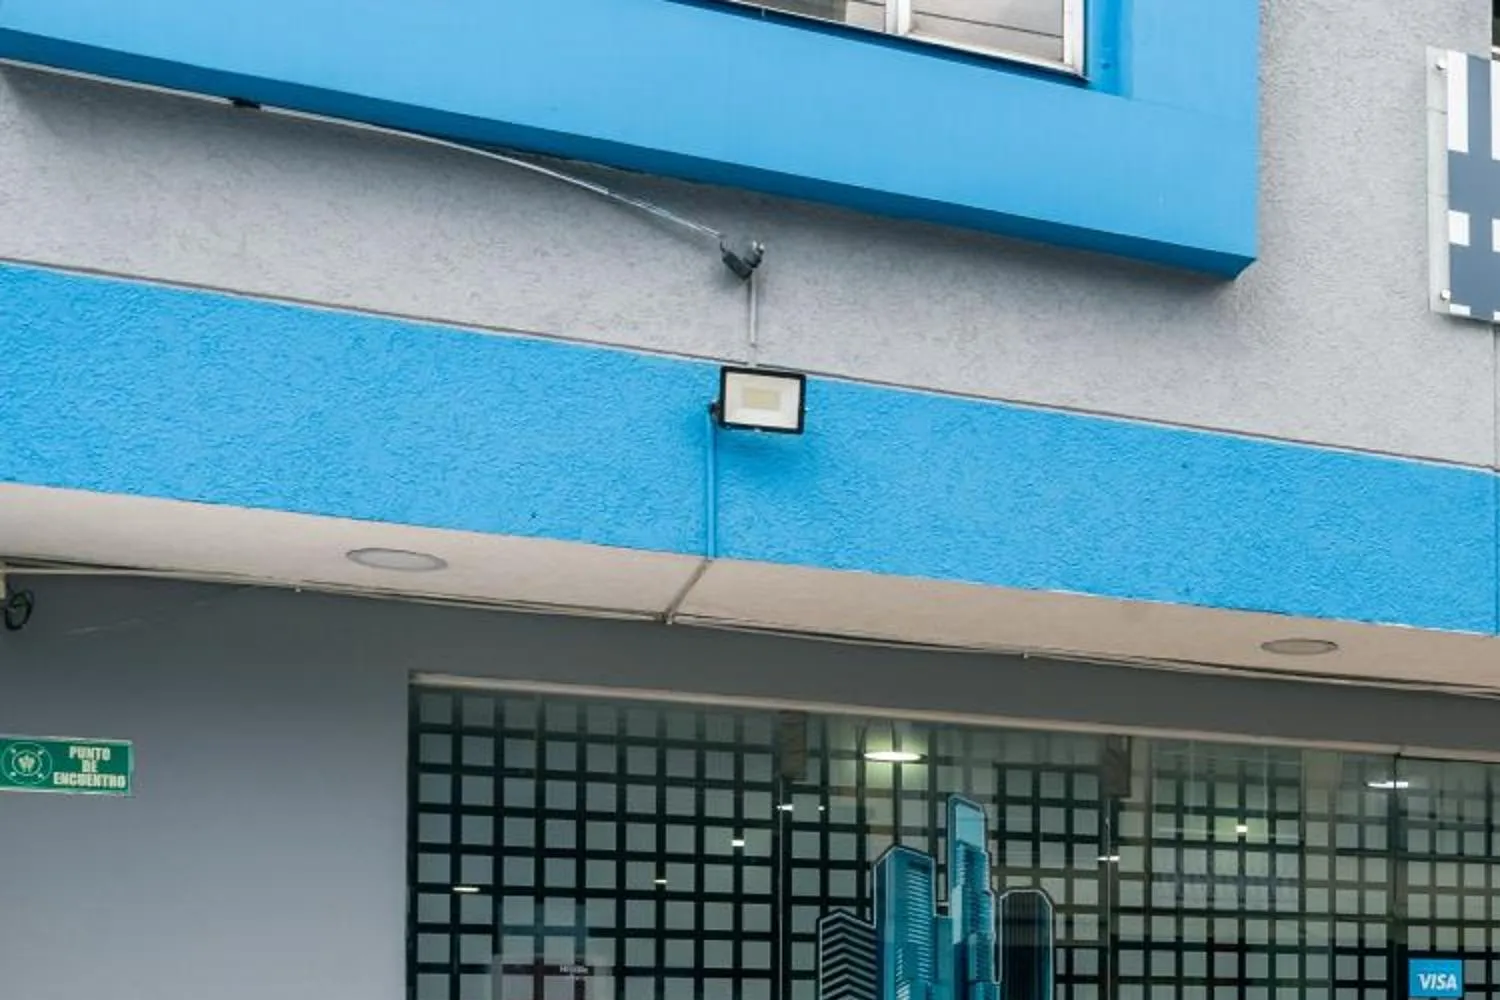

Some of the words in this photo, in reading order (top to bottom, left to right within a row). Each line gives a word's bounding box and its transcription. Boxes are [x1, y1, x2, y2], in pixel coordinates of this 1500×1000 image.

[69, 745, 111, 761] PUNTO
[81, 760, 99, 773] DE
[53, 771, 126, 789] ENCUENTRO
[1416, 972, 1458, 991] VISA
